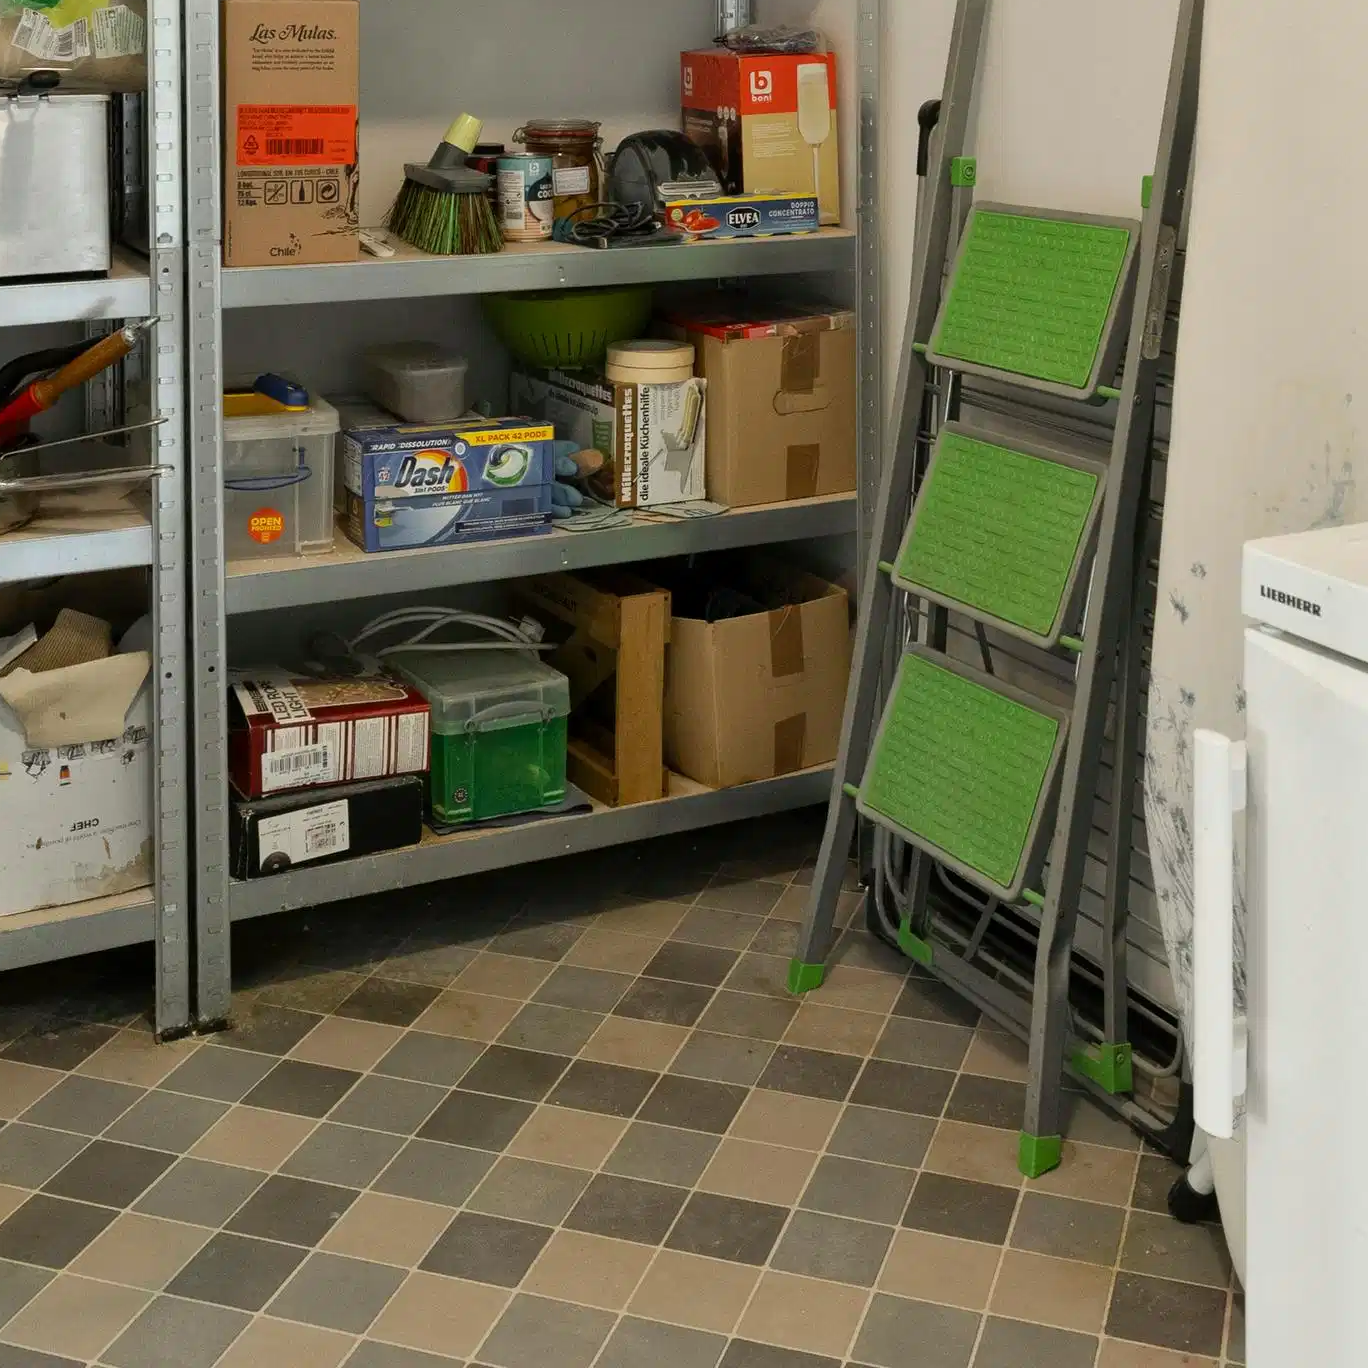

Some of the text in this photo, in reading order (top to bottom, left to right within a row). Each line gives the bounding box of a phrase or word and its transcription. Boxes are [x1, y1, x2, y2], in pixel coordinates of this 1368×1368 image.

[249, 23, 277, 44] Las
[751, 95, 772, 103] boni
[768, 208, 815, 217] CONCENTRATO
[791, 201, 815, 209] DOPPIO
[728, 212, 759, 225] ELVEA
[269, 247, 296, 257] Chile
[475, 435, 487, 443] XL
[488, 433, 510, 441] PACK
[524, 430, 547, 438] PODS
[639, 387, 650, 501] die ideale Küchenhilfe
[621, 388, 633, 502] Millecroquettes
[394, 456, 455, 488] Dash
[251, 517, 281, 525] OPEN
[1260, 585, 1321, 617] LIEBHERR
[271, 701, 292, 720] LED
[282, 692, 308, 718] LIGHT
[70, 818, 100, 833] CHEF
